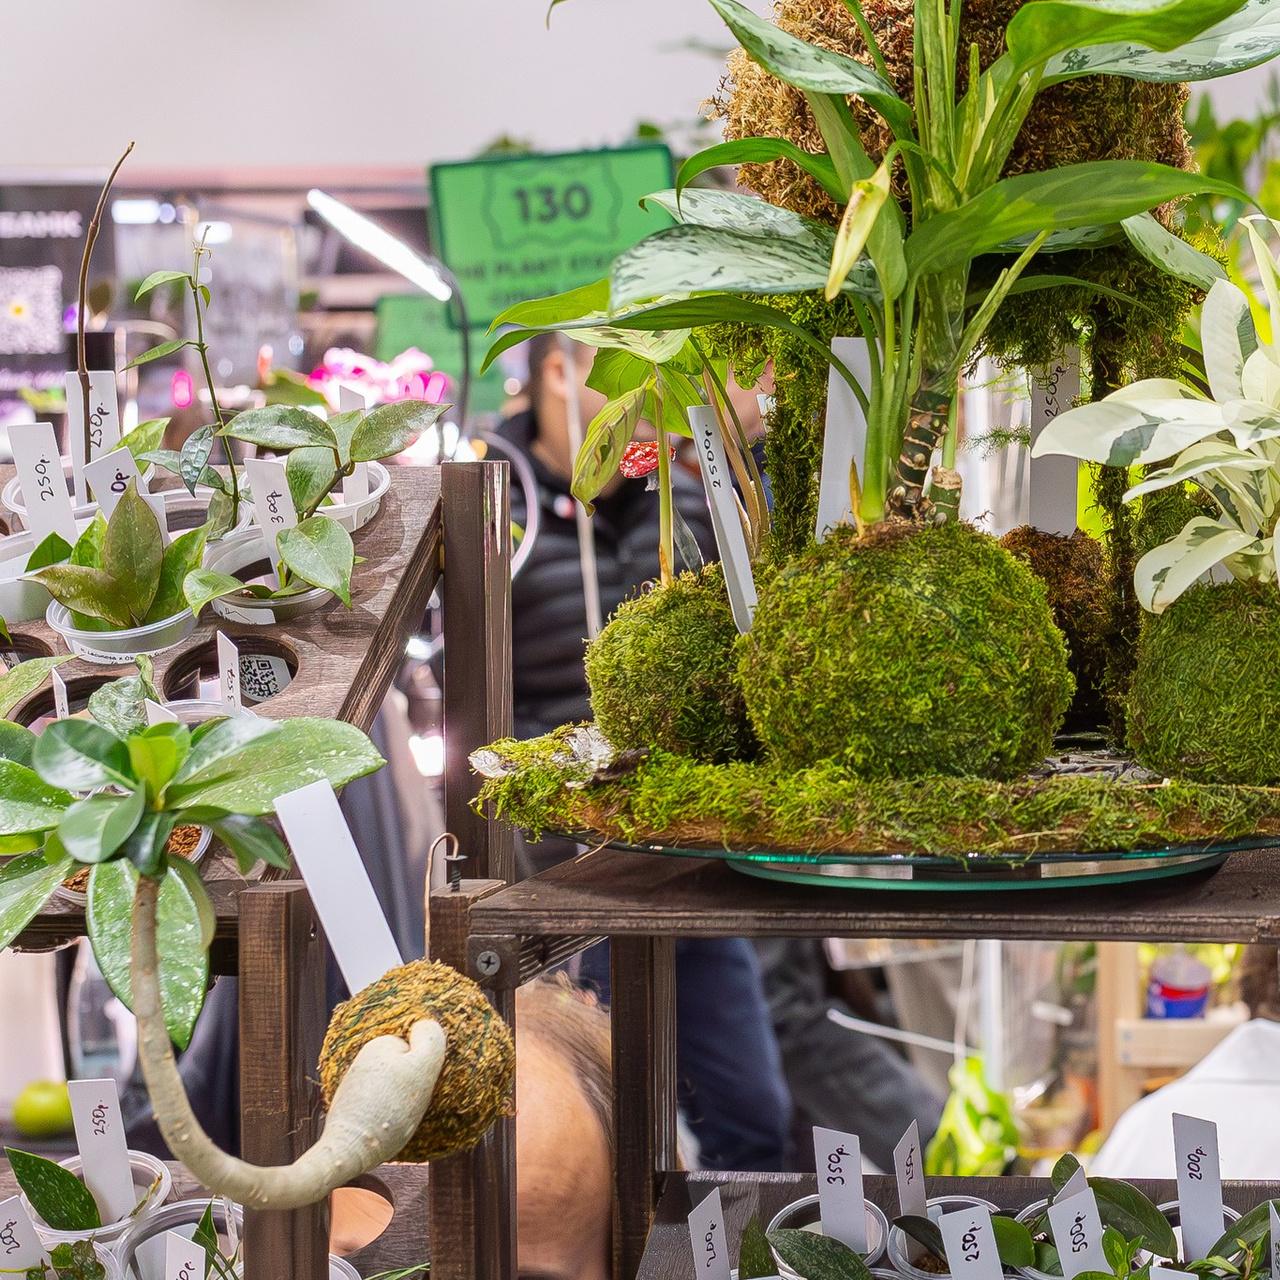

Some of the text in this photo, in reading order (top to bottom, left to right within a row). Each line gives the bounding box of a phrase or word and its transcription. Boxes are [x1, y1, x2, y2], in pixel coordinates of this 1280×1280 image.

[513, 183, 594, 222] 130
[703, 424, 722, 489] 2500р.
[34, 454, 55, 502] 250р.
[91, 1099, 110, 1136] 250р.
[826, 1144, 852, 1187] 350р.
[1187, 1146, 1208, 1181] 200р.
[961, 1221, 983, 1263] 250р.
[1069, 1211, 1088, 1254] 500р.
